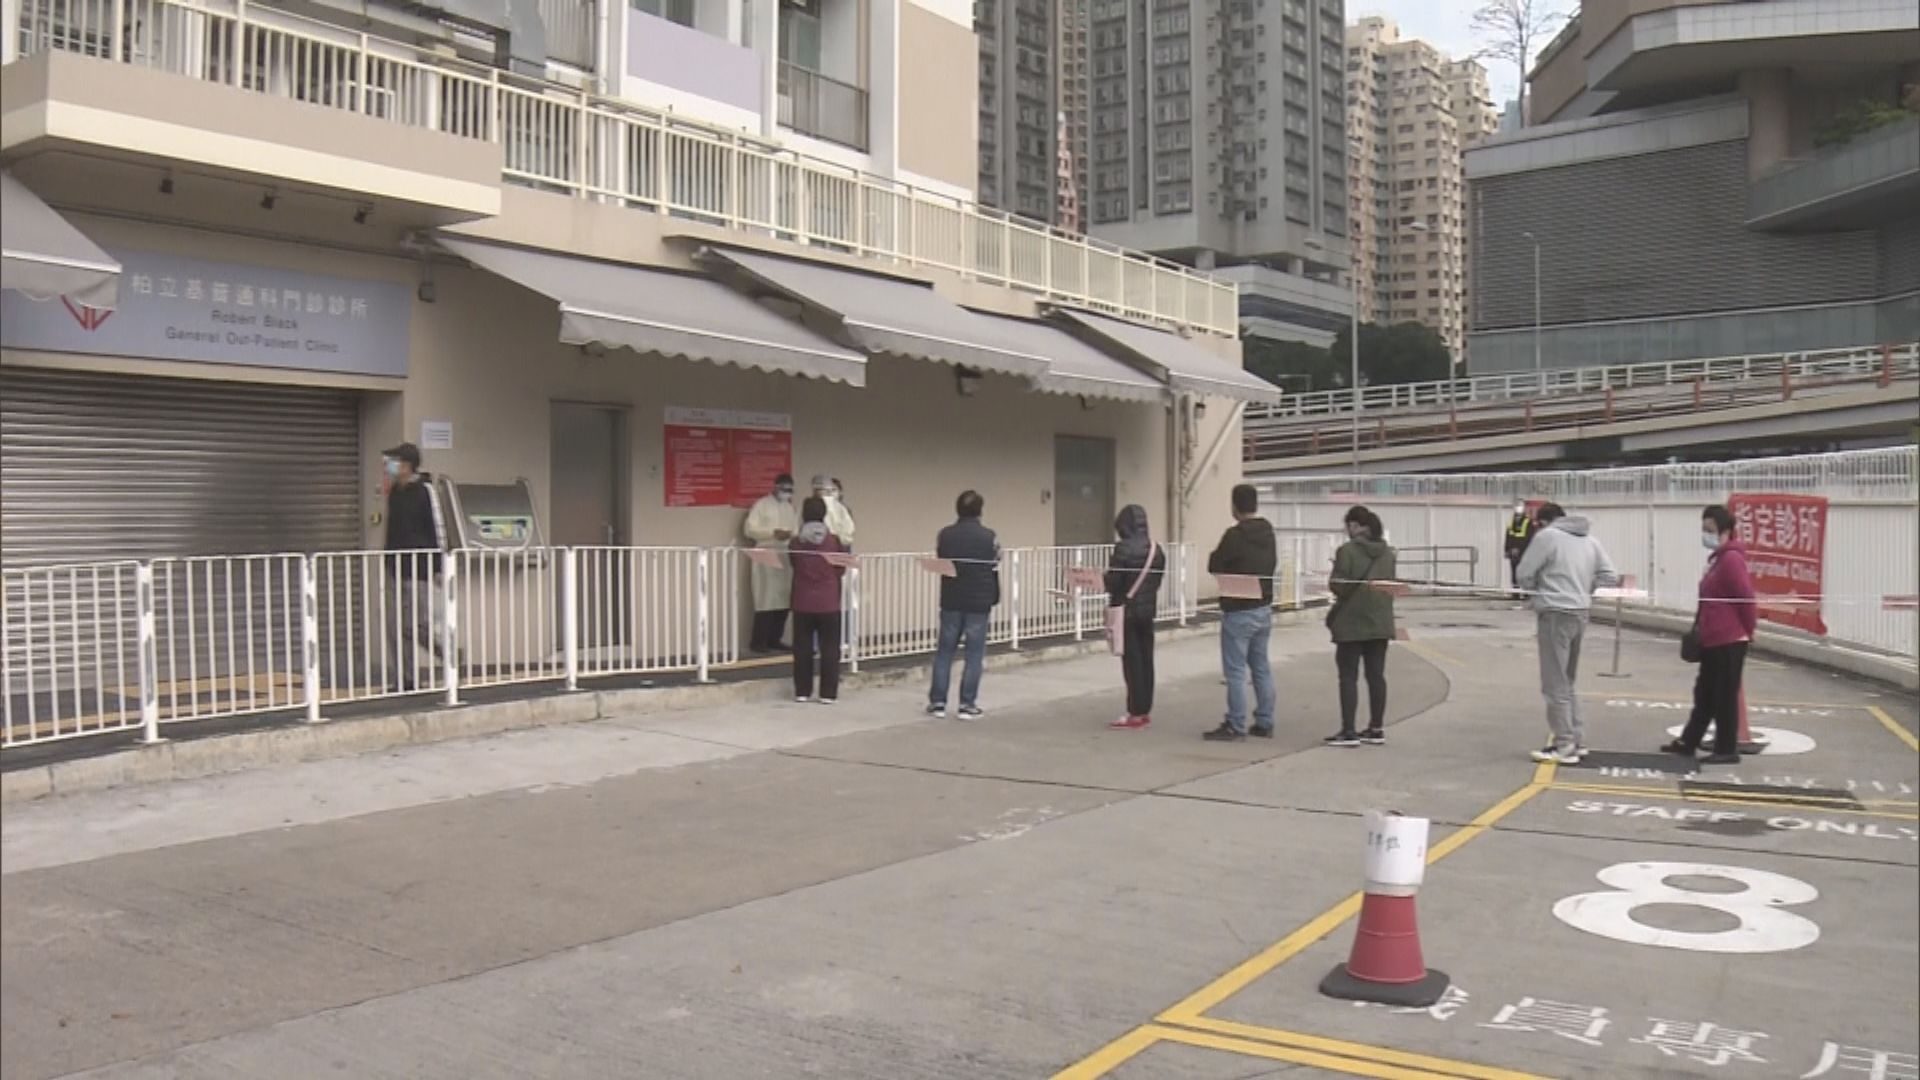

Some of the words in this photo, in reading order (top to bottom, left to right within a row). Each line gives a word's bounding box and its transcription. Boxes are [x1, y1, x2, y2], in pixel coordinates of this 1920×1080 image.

[211, 309, 257, 326] Robert
[263, 314, 298, 330] Black
[165, 325, 221, 344] General
[1734, 501, 1820, 555] 指定診所
[1791, 561, 1819, 584] Clinic
[1566, 800, 1749, 823] STAFF
[1552, 861, 1821, 953] 8
